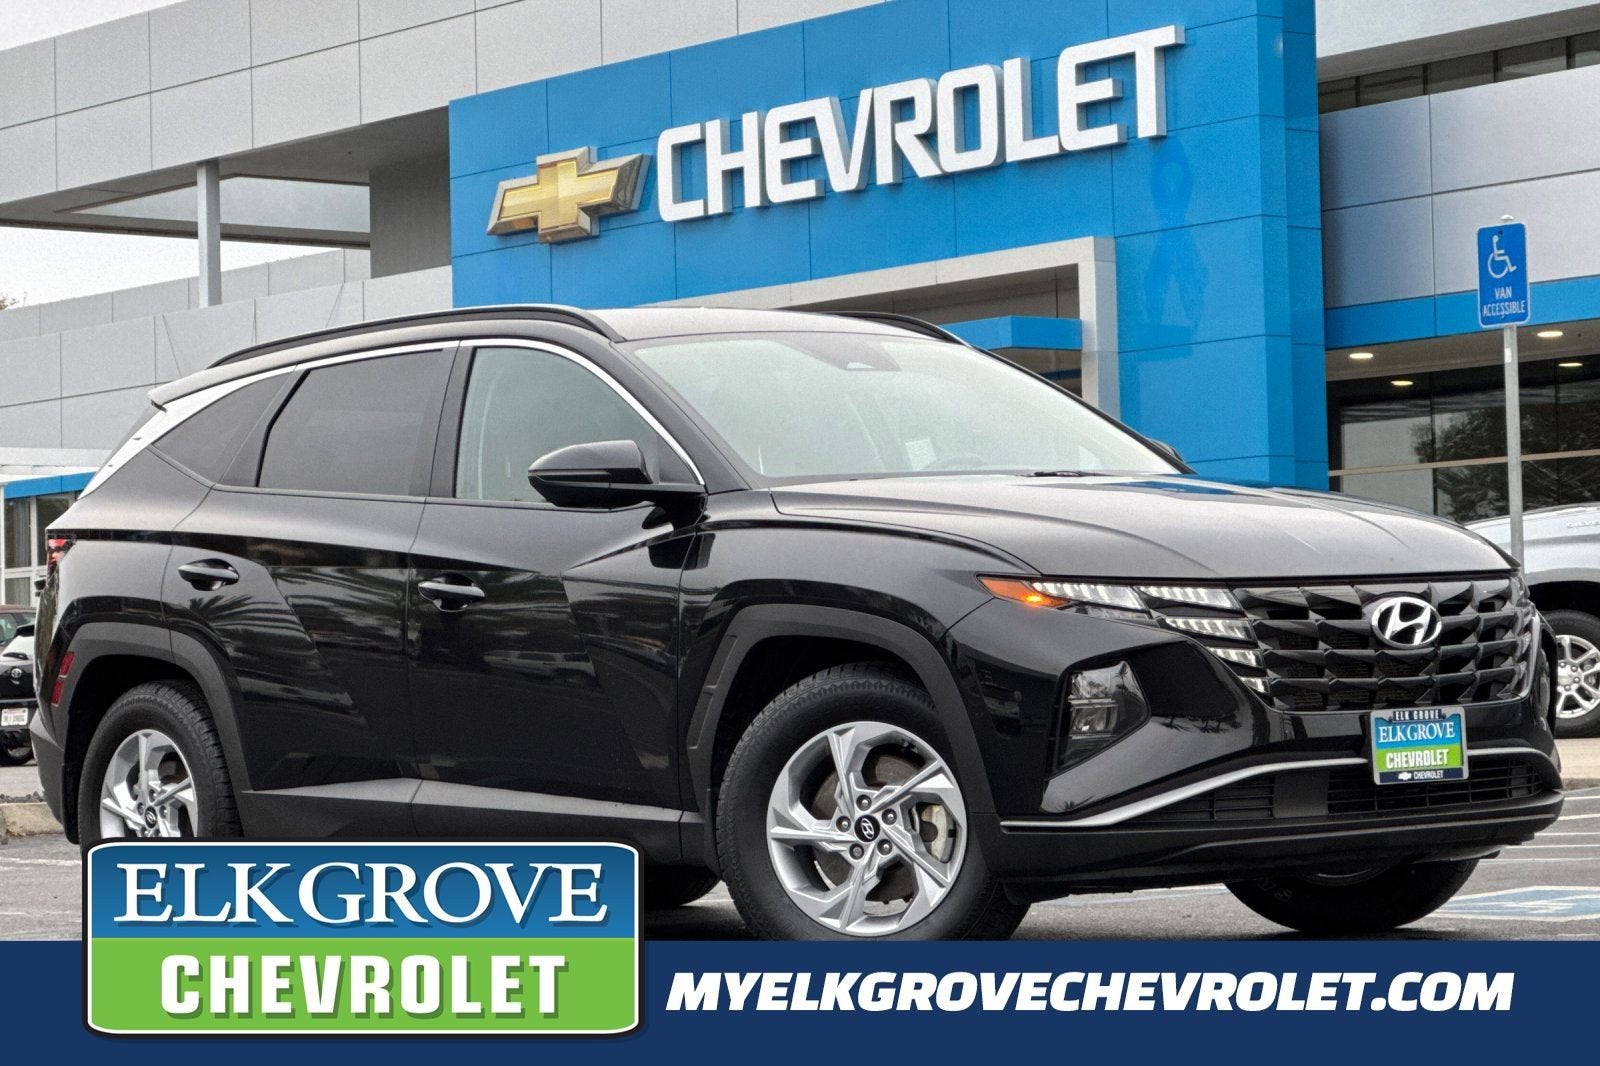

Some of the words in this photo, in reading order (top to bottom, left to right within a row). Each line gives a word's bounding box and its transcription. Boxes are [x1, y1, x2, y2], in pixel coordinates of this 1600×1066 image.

[657, 24, 1185, 223] CHEVROLET
[1494, 286, 1512, 299] VAN
[1483, 300, 1526, 317] ACCESSIBLE
[1395, 711, 1408, 721] ELK
[1413, 709, 1439, 720] GROVE
[1378, 725, 1407, 743] ELK
[1407, 722, 1455, 740] GROVE
[1385, 749, 1449, 769] CHEVROLET
[1413, 770, 1444, 780] CHEVROLET
